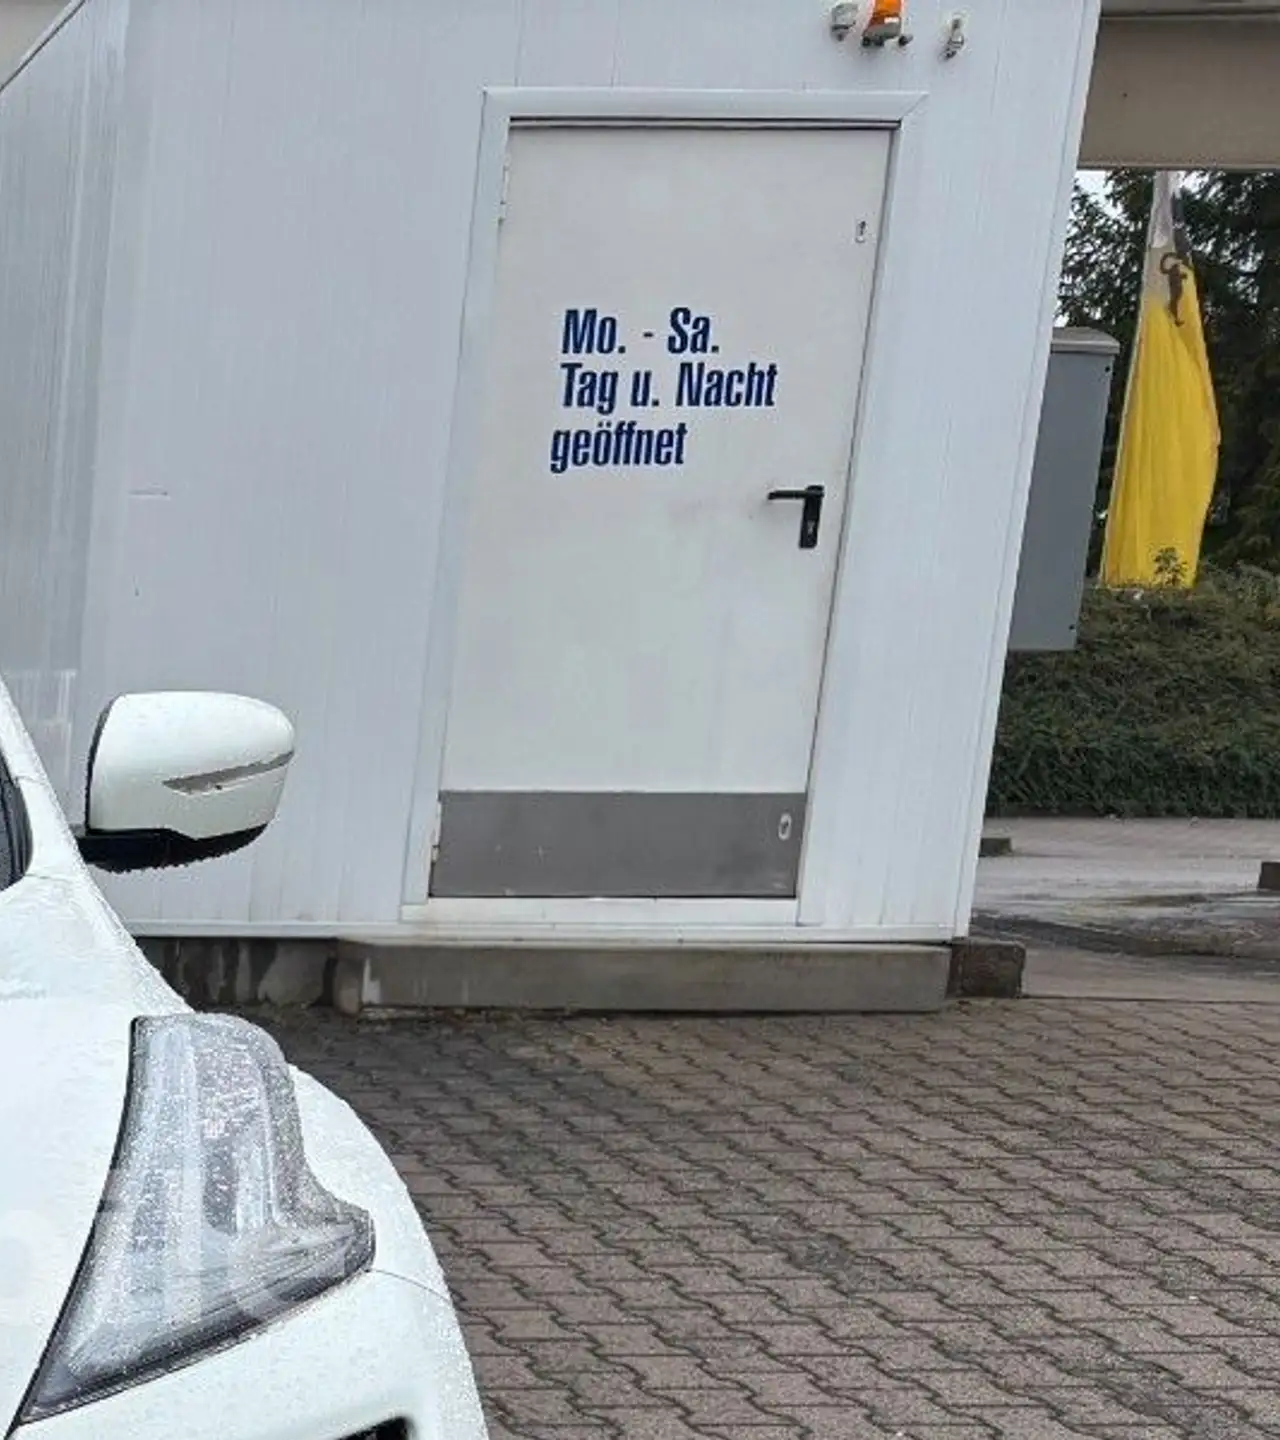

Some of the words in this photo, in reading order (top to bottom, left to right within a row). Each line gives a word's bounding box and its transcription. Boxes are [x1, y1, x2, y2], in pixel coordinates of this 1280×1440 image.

[561, 308, 626, 355] Mo.
[667, 306, 720, 355] Sa.
[560, 361, 619, 416] Tag
[630, 370, 660, 408] u.
[675, 361, 778, 408] Nacht
[550, 420, 689, 475] geöffnet
